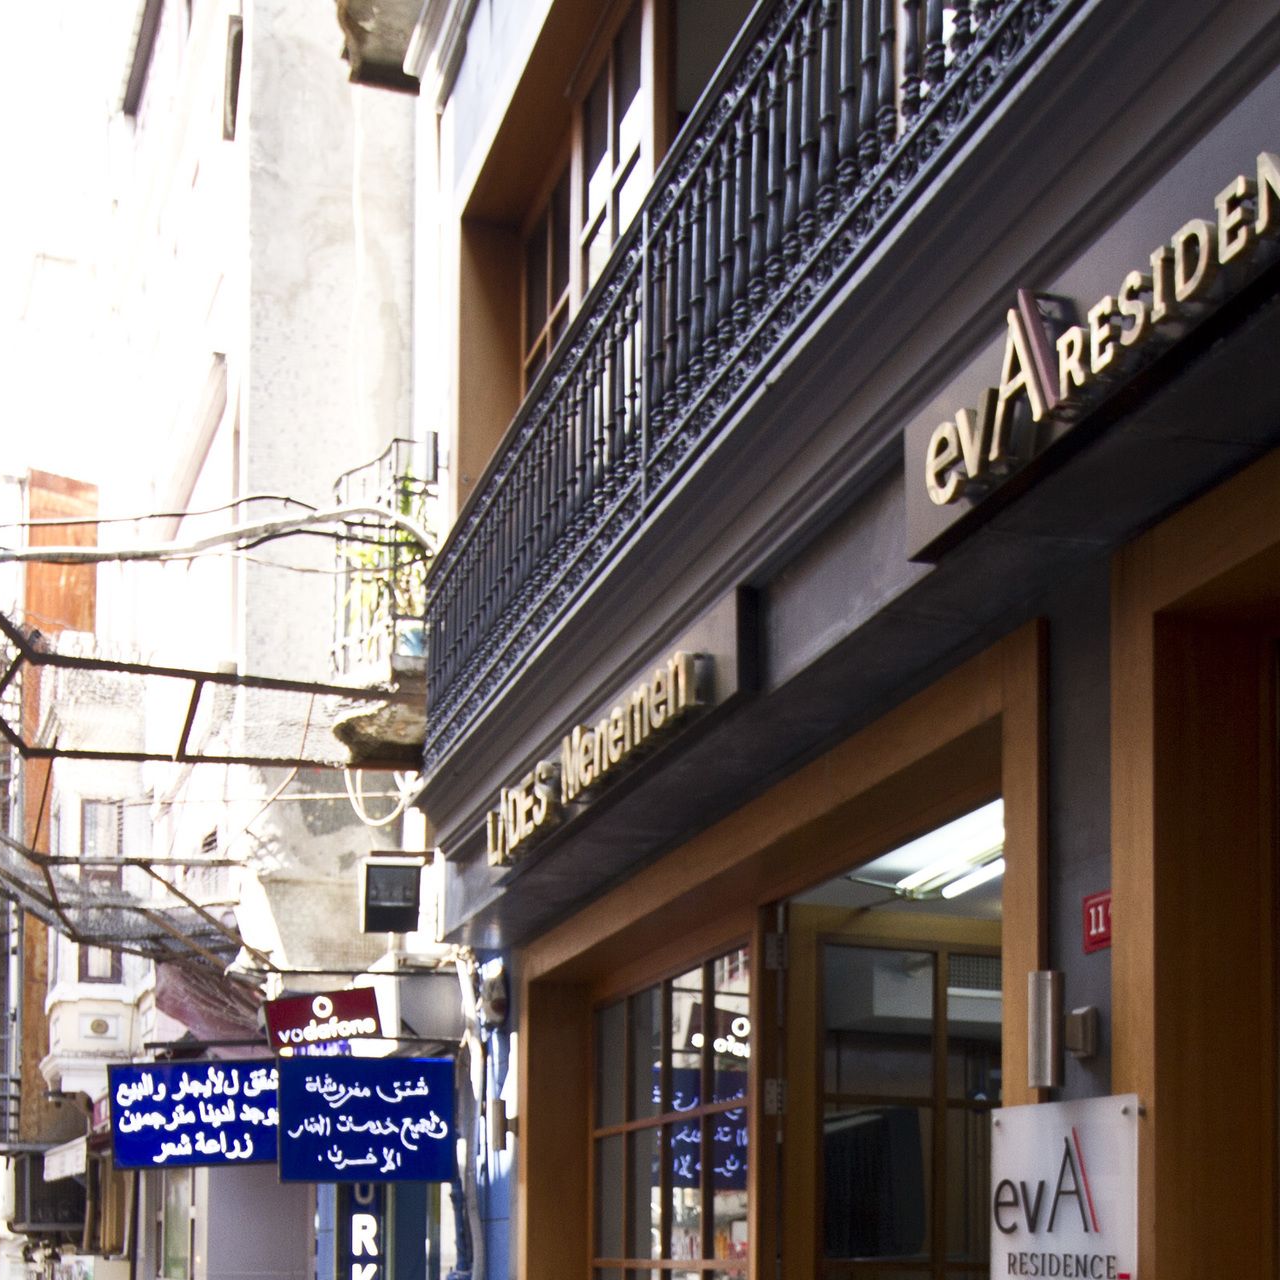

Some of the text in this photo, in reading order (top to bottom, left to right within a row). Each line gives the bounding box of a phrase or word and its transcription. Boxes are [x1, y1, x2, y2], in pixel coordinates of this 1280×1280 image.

[487, 650, 696, 866] LADES Menemen
[1089, 904, 1105, 936] 11
[278, 1016, 376, 1043] vodafone
